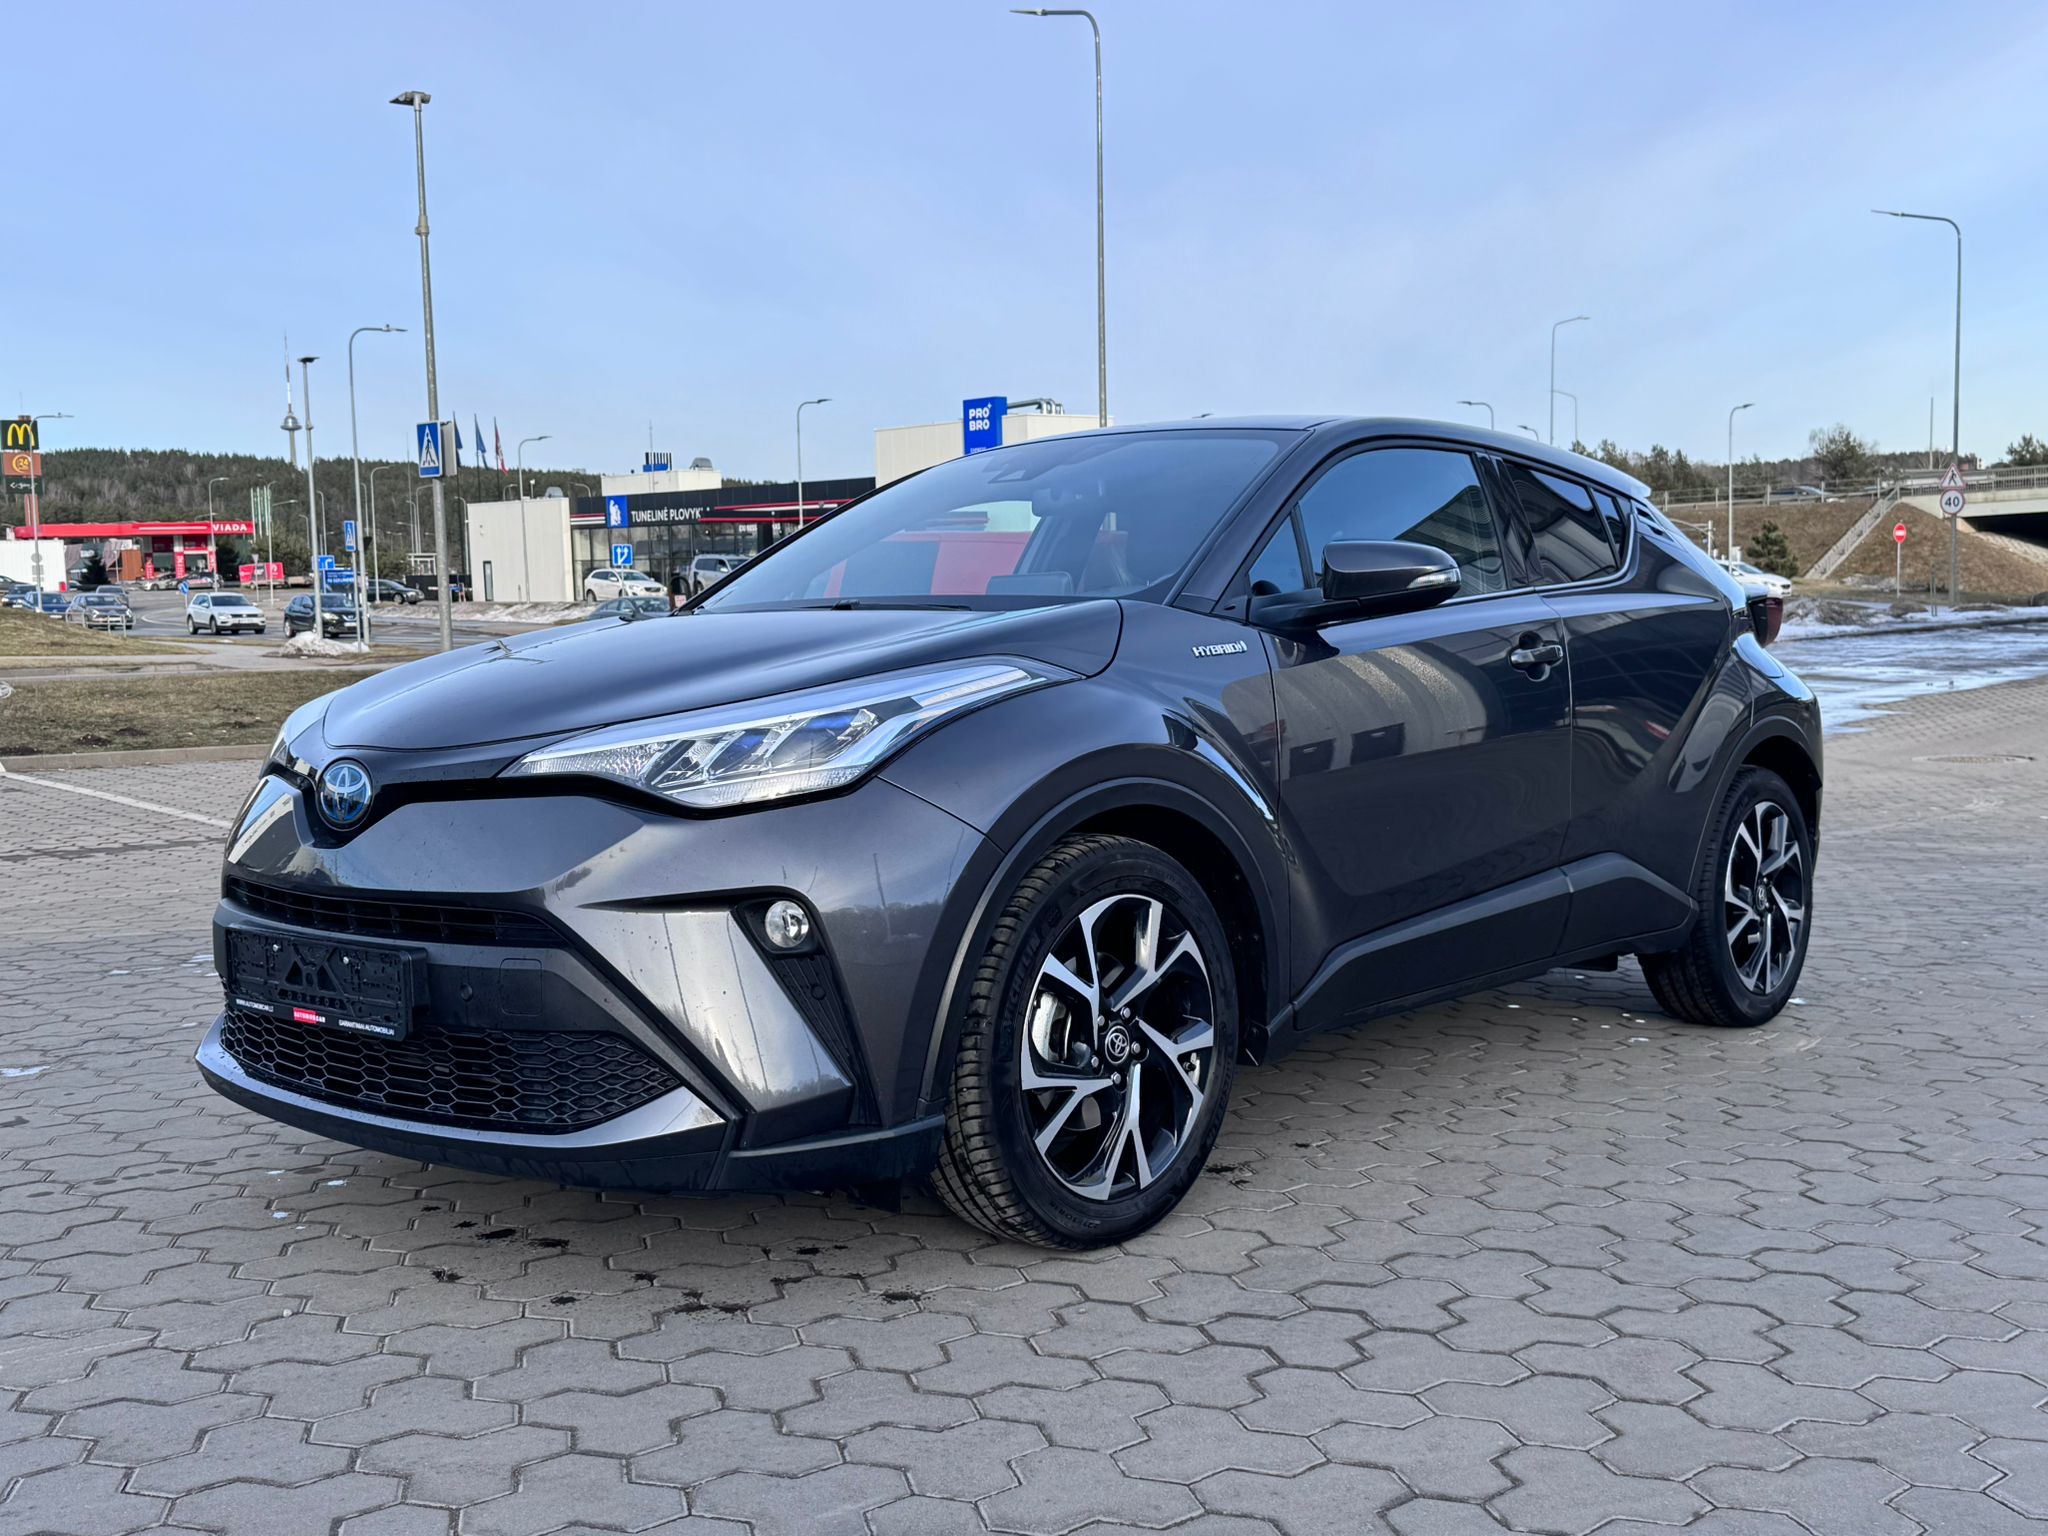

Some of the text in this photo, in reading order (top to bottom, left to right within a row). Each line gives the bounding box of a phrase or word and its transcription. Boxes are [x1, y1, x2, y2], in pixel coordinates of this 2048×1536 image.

[969, 407, 990, 419] PRO
[969, 419, 990, 431] BRO
[1945, 496, 1960, 507] 40
[631, 507, 703, 523] TUNELINĖ PLOVYK
[213, 523, 247, 531] VIADA
[1192, 642, 1239, 657] HYBRID
